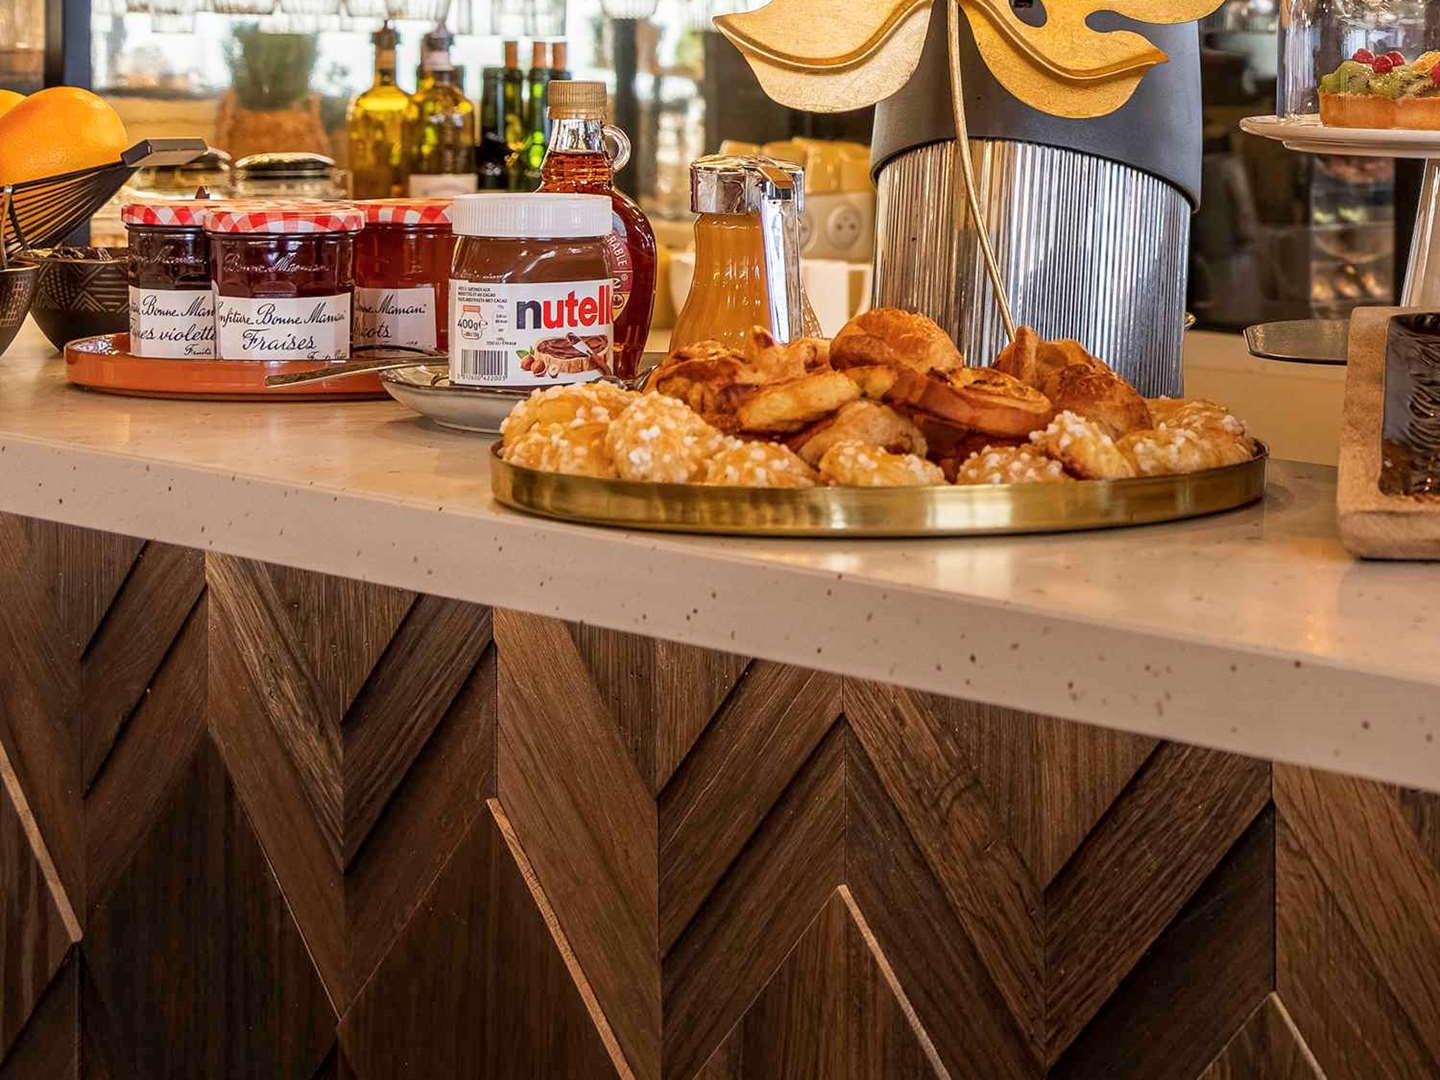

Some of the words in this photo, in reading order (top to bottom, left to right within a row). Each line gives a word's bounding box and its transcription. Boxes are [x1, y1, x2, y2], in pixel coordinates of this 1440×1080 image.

[140, 294, 179, 317] Bonne
[180, 295, 215, 317] Mam
[218, 301, 254, 328] nfiture
[255, 302, 302, 325] Bonne
[374, 294, 425, 315] Maman
[516, 285, 612, 329] nutell
[242, 328, 317, 351] Fraises
